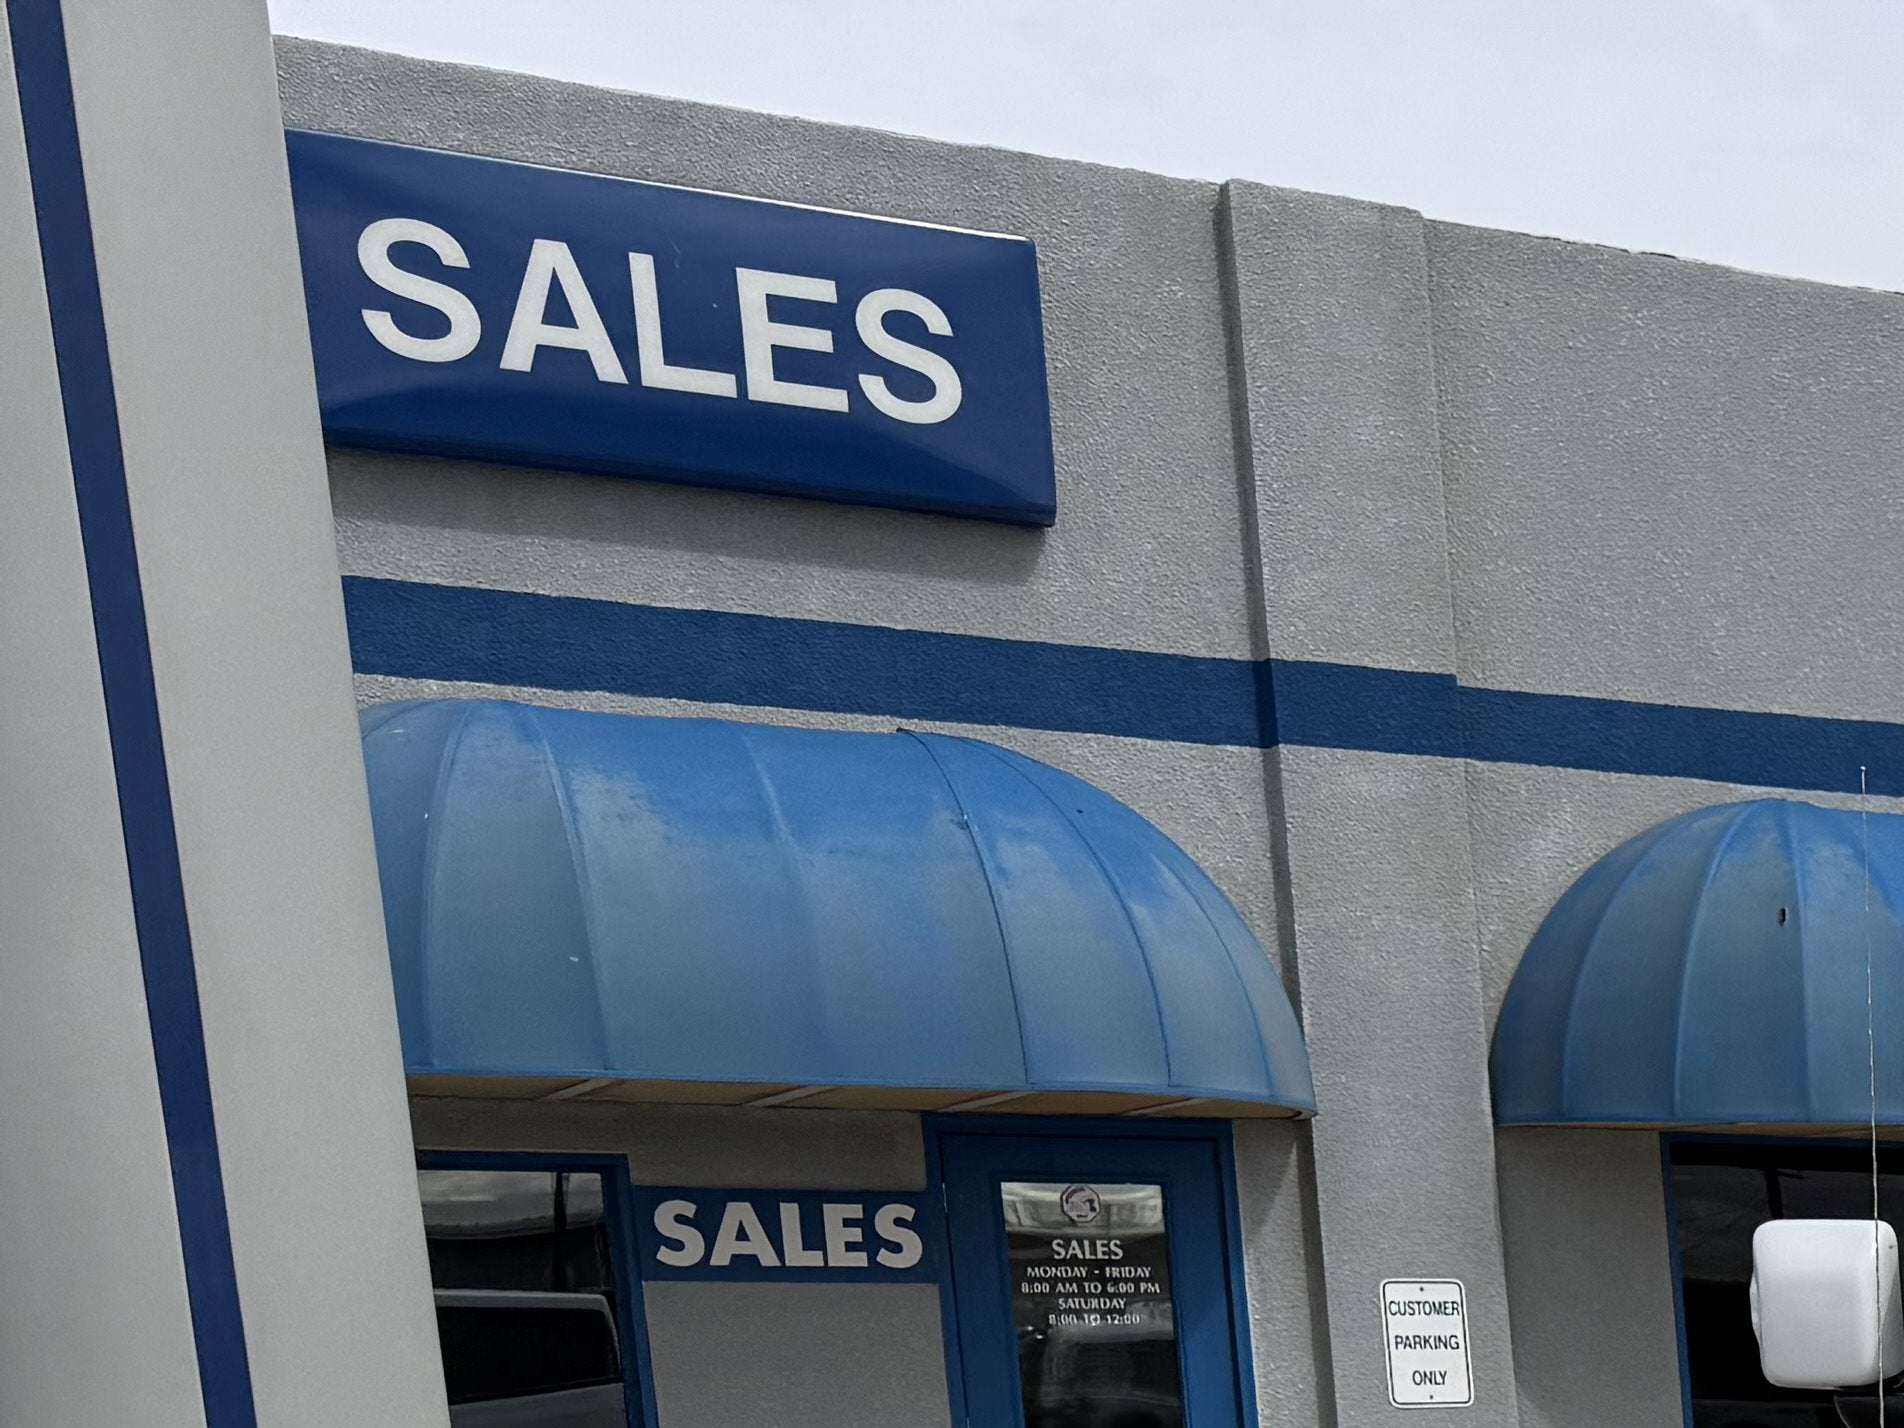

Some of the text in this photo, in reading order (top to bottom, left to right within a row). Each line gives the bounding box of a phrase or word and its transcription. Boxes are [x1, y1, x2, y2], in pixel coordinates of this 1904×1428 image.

[357, 217, 963, 425] SALES
[653, 1199, 924, 1269] SALES
[1051, 1238, 1124, 1260] SALES
[1026, 1265, 1088, 1279] MONDAY
[1104, 1265, 1152, 1279] FRIDAY
[1021, 1281, 1161, 1294] 8:00 AM TO 6:00 PM
[1058, 1297, 1127, 1310] SATURDAY
[1388, 1300, 1460, 1316] CUSTOMER
[1083, 1313, 1101, 1326] TO
[1394, 1334, 1460, 1350] PARKING
[1412, 1369, 1447, 1386] ONLY
